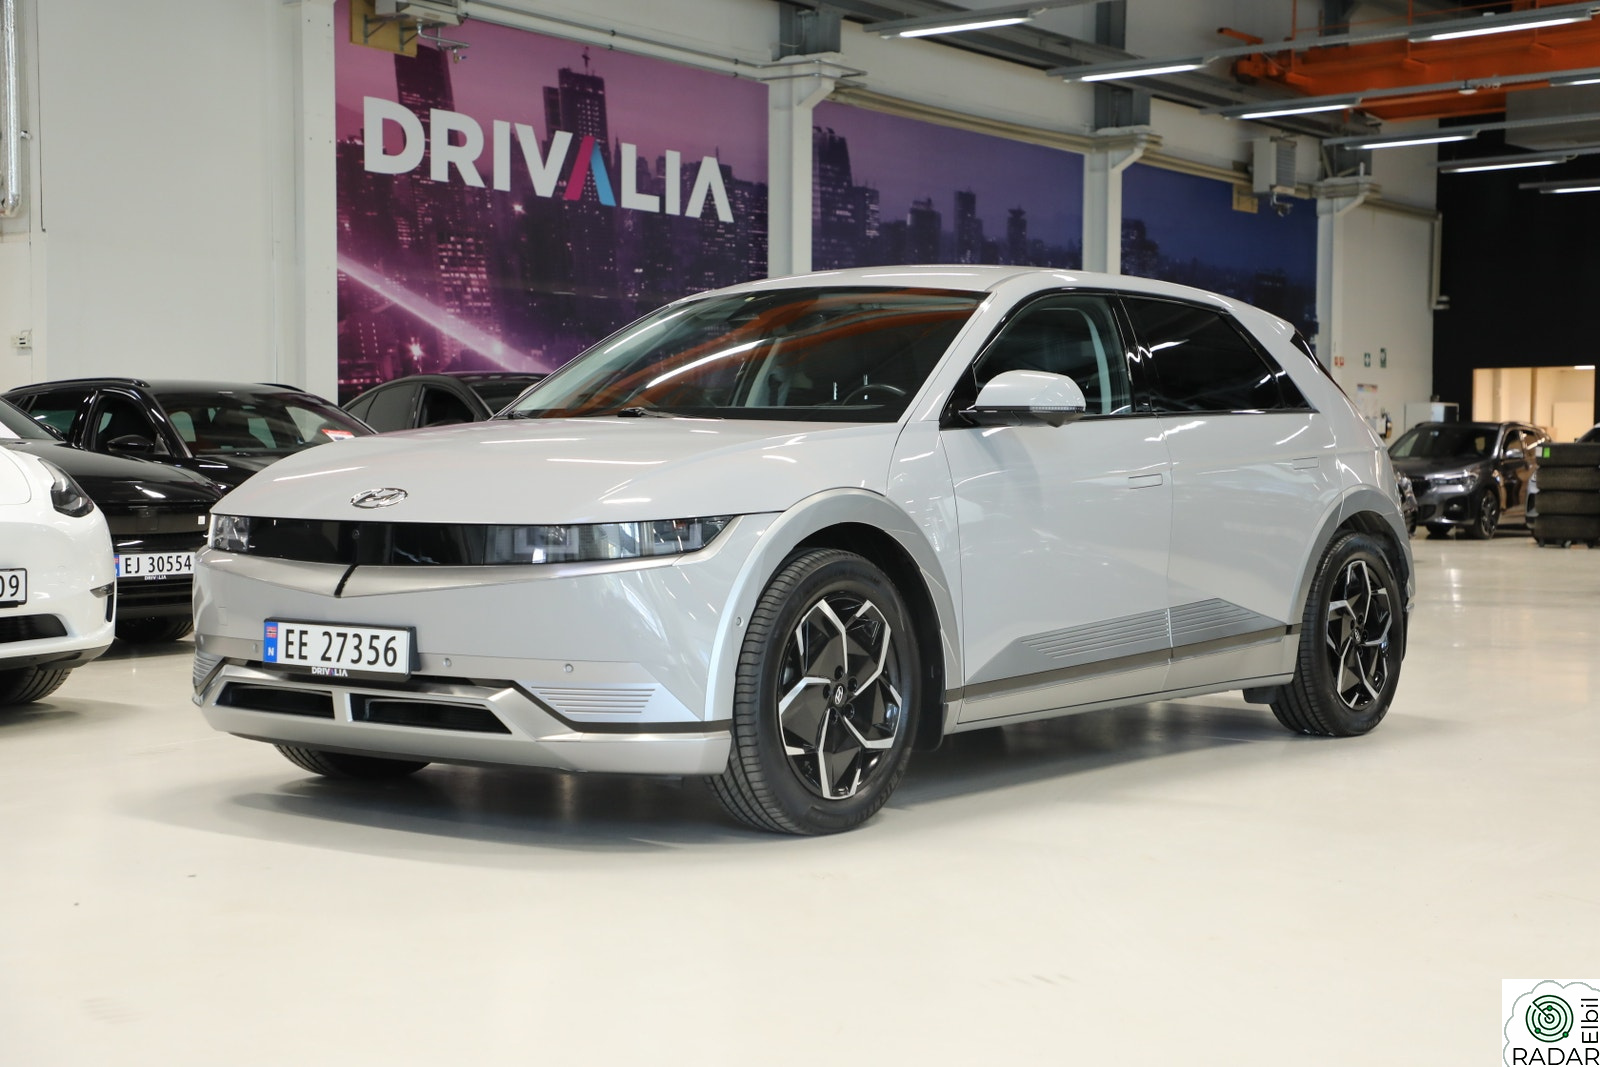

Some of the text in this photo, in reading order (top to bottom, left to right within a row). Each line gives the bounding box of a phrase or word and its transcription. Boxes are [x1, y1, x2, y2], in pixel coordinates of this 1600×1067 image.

[363, 95, 734, 223] DRIVALIA
[125, 555, 192, 574] EJ 30554
[268, 647, 274, 656] N
[285, 629, 397, 667] EE 27356
[311, 666, 348, 678] DRIVALIA
